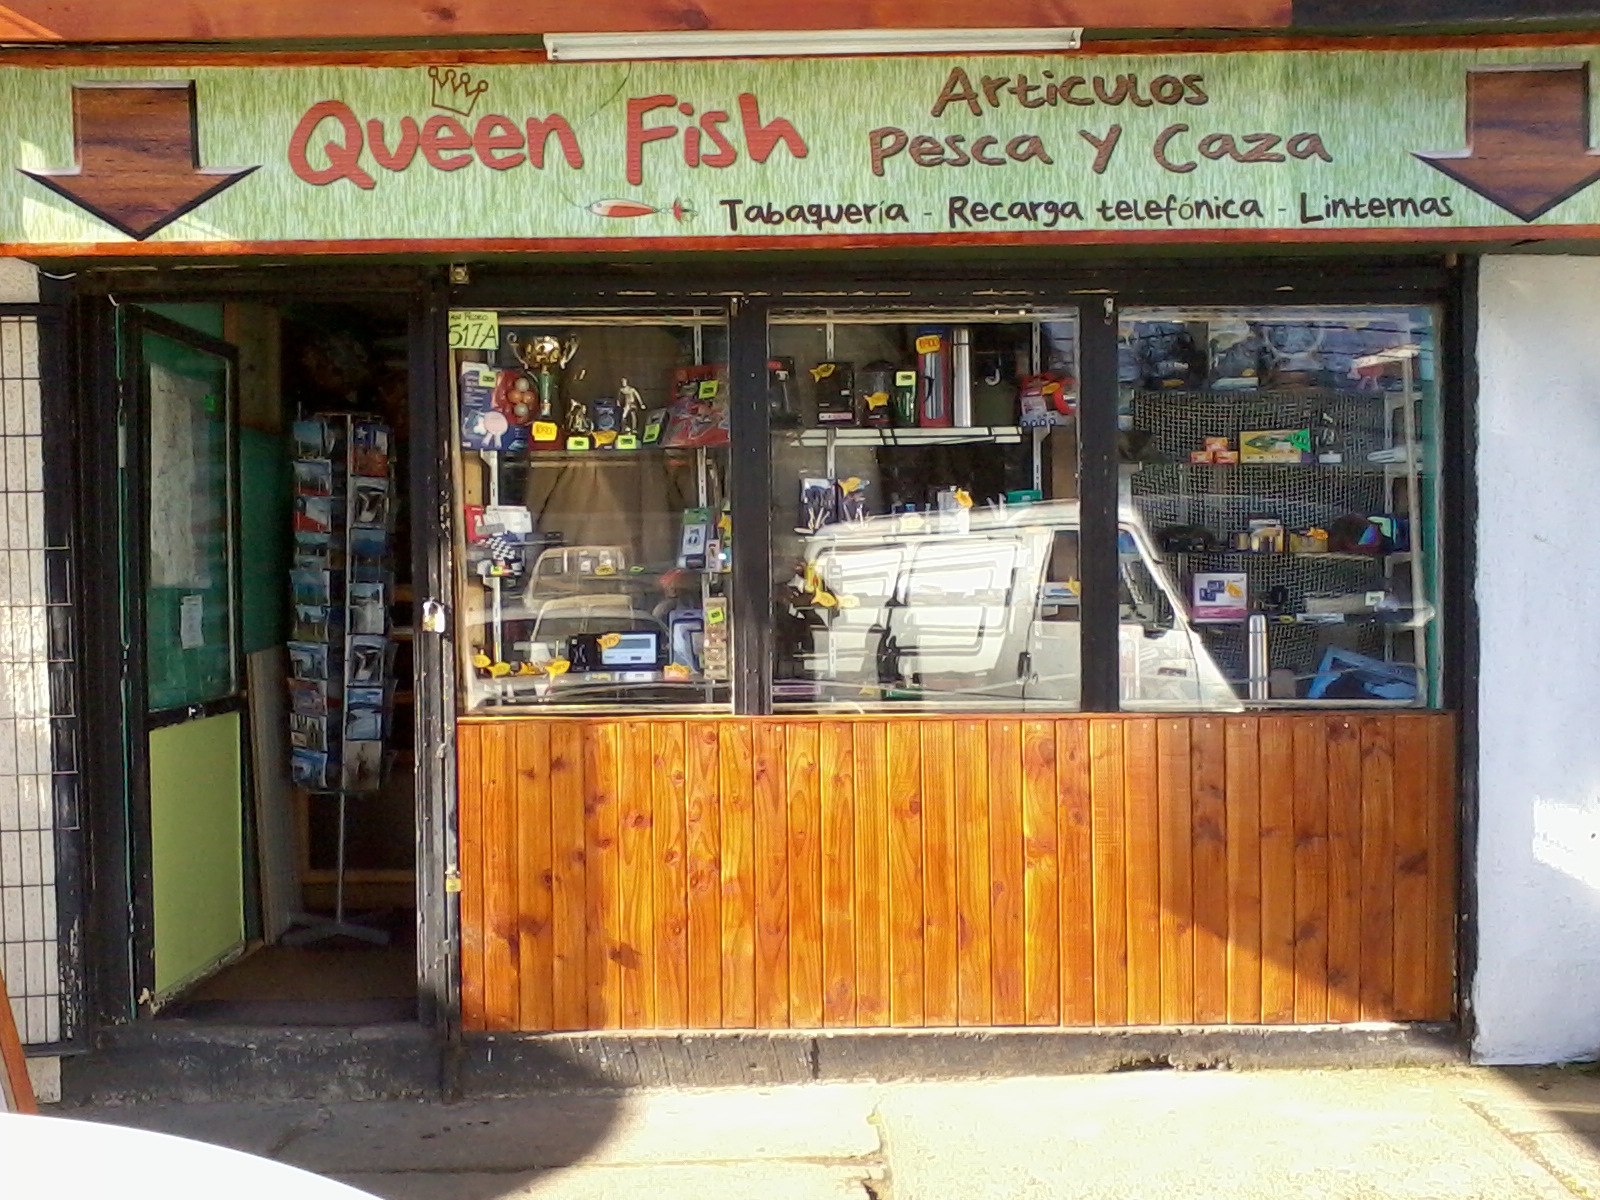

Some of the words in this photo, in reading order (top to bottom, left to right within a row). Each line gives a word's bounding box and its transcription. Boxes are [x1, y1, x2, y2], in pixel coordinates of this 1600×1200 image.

[929, 66, 1210, 117] Articulos
[288, 100, 584, 190] Queen
[626, 92, 808, 186] Fish
[869, 126, 1054, 176] Pesca
[1153, 123, 1333, 173] Caza
[719, 199, 909, 231] Tabaquería
[949, 196, 1084, 228] Recarga
[1096, 193, 1263, 226] telefónica
[1300, 192, 1453, 224] Linternas
